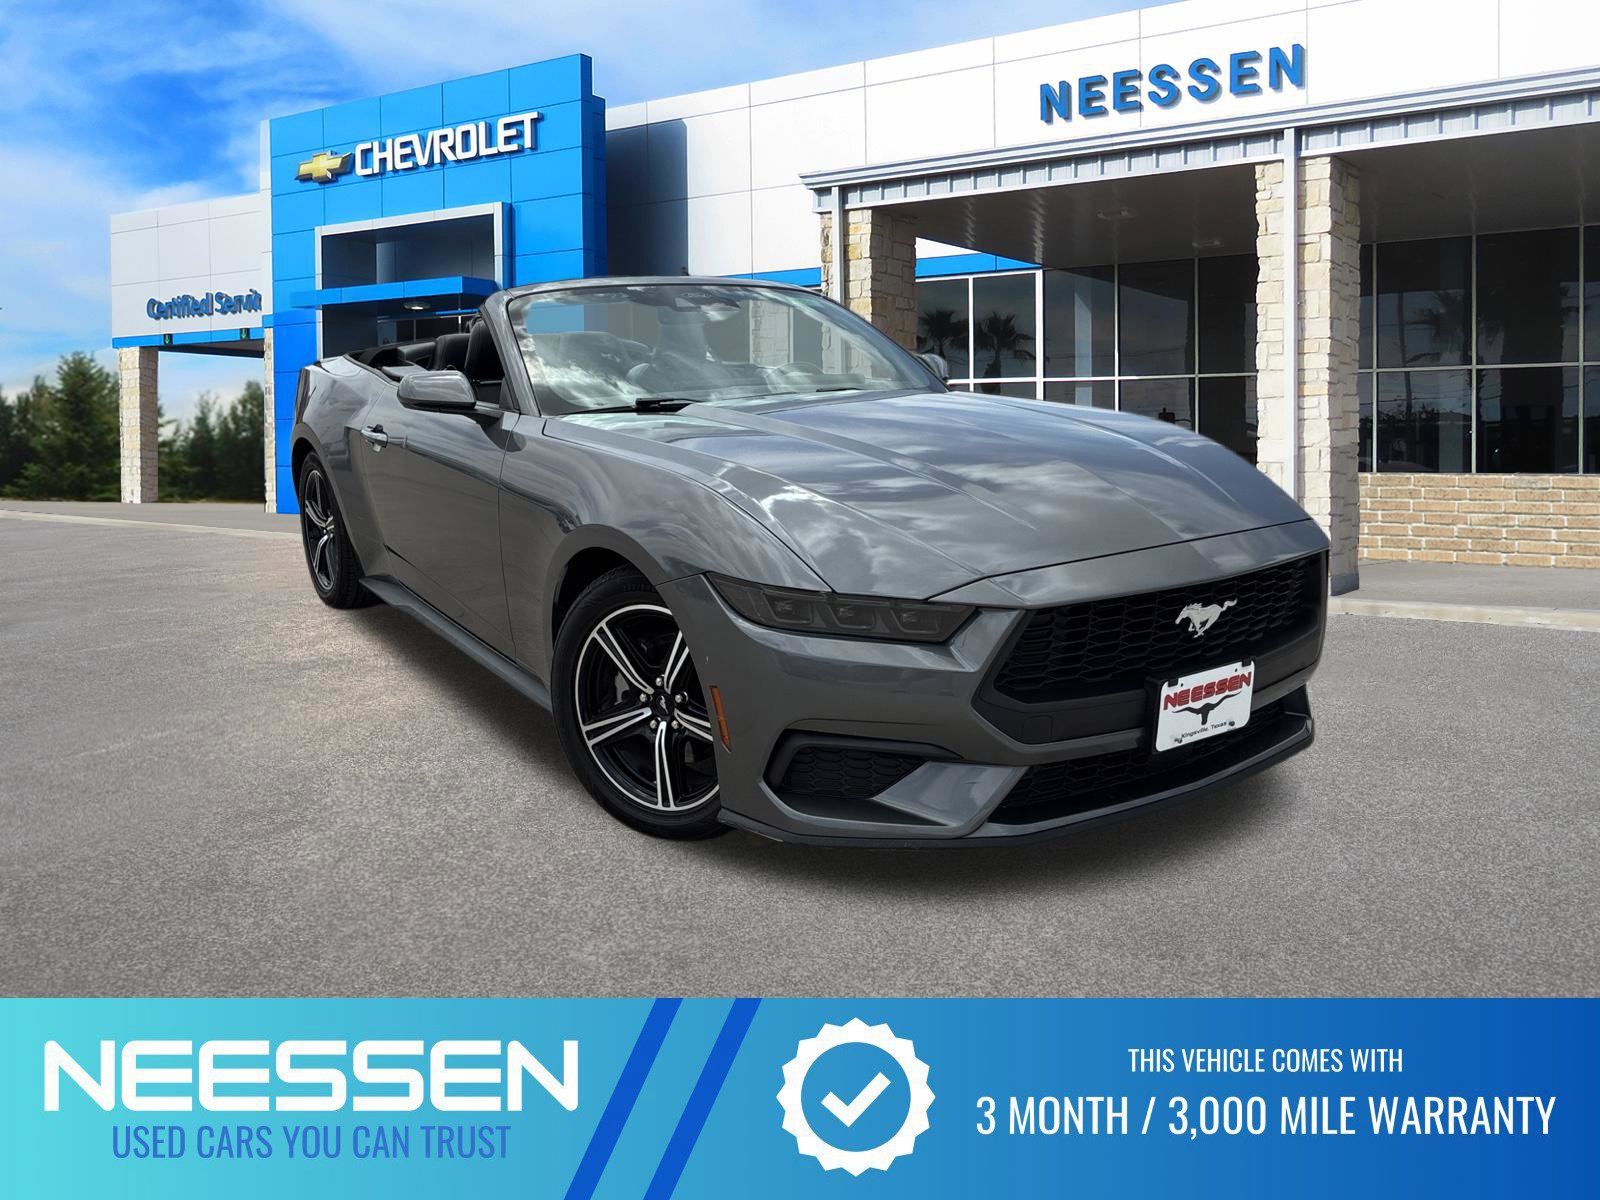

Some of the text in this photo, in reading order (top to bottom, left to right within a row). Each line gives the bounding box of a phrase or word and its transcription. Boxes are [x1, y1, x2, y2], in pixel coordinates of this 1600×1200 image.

[1040, 44, 1305, 123] NEESSEN
[354, 111, 541, 176] CHEVROLET
[147, 292, 213, 320] Certified
[1163, 671, 1252, 711] NEESSEN
[1211, 721, 1227, 730] Texas
